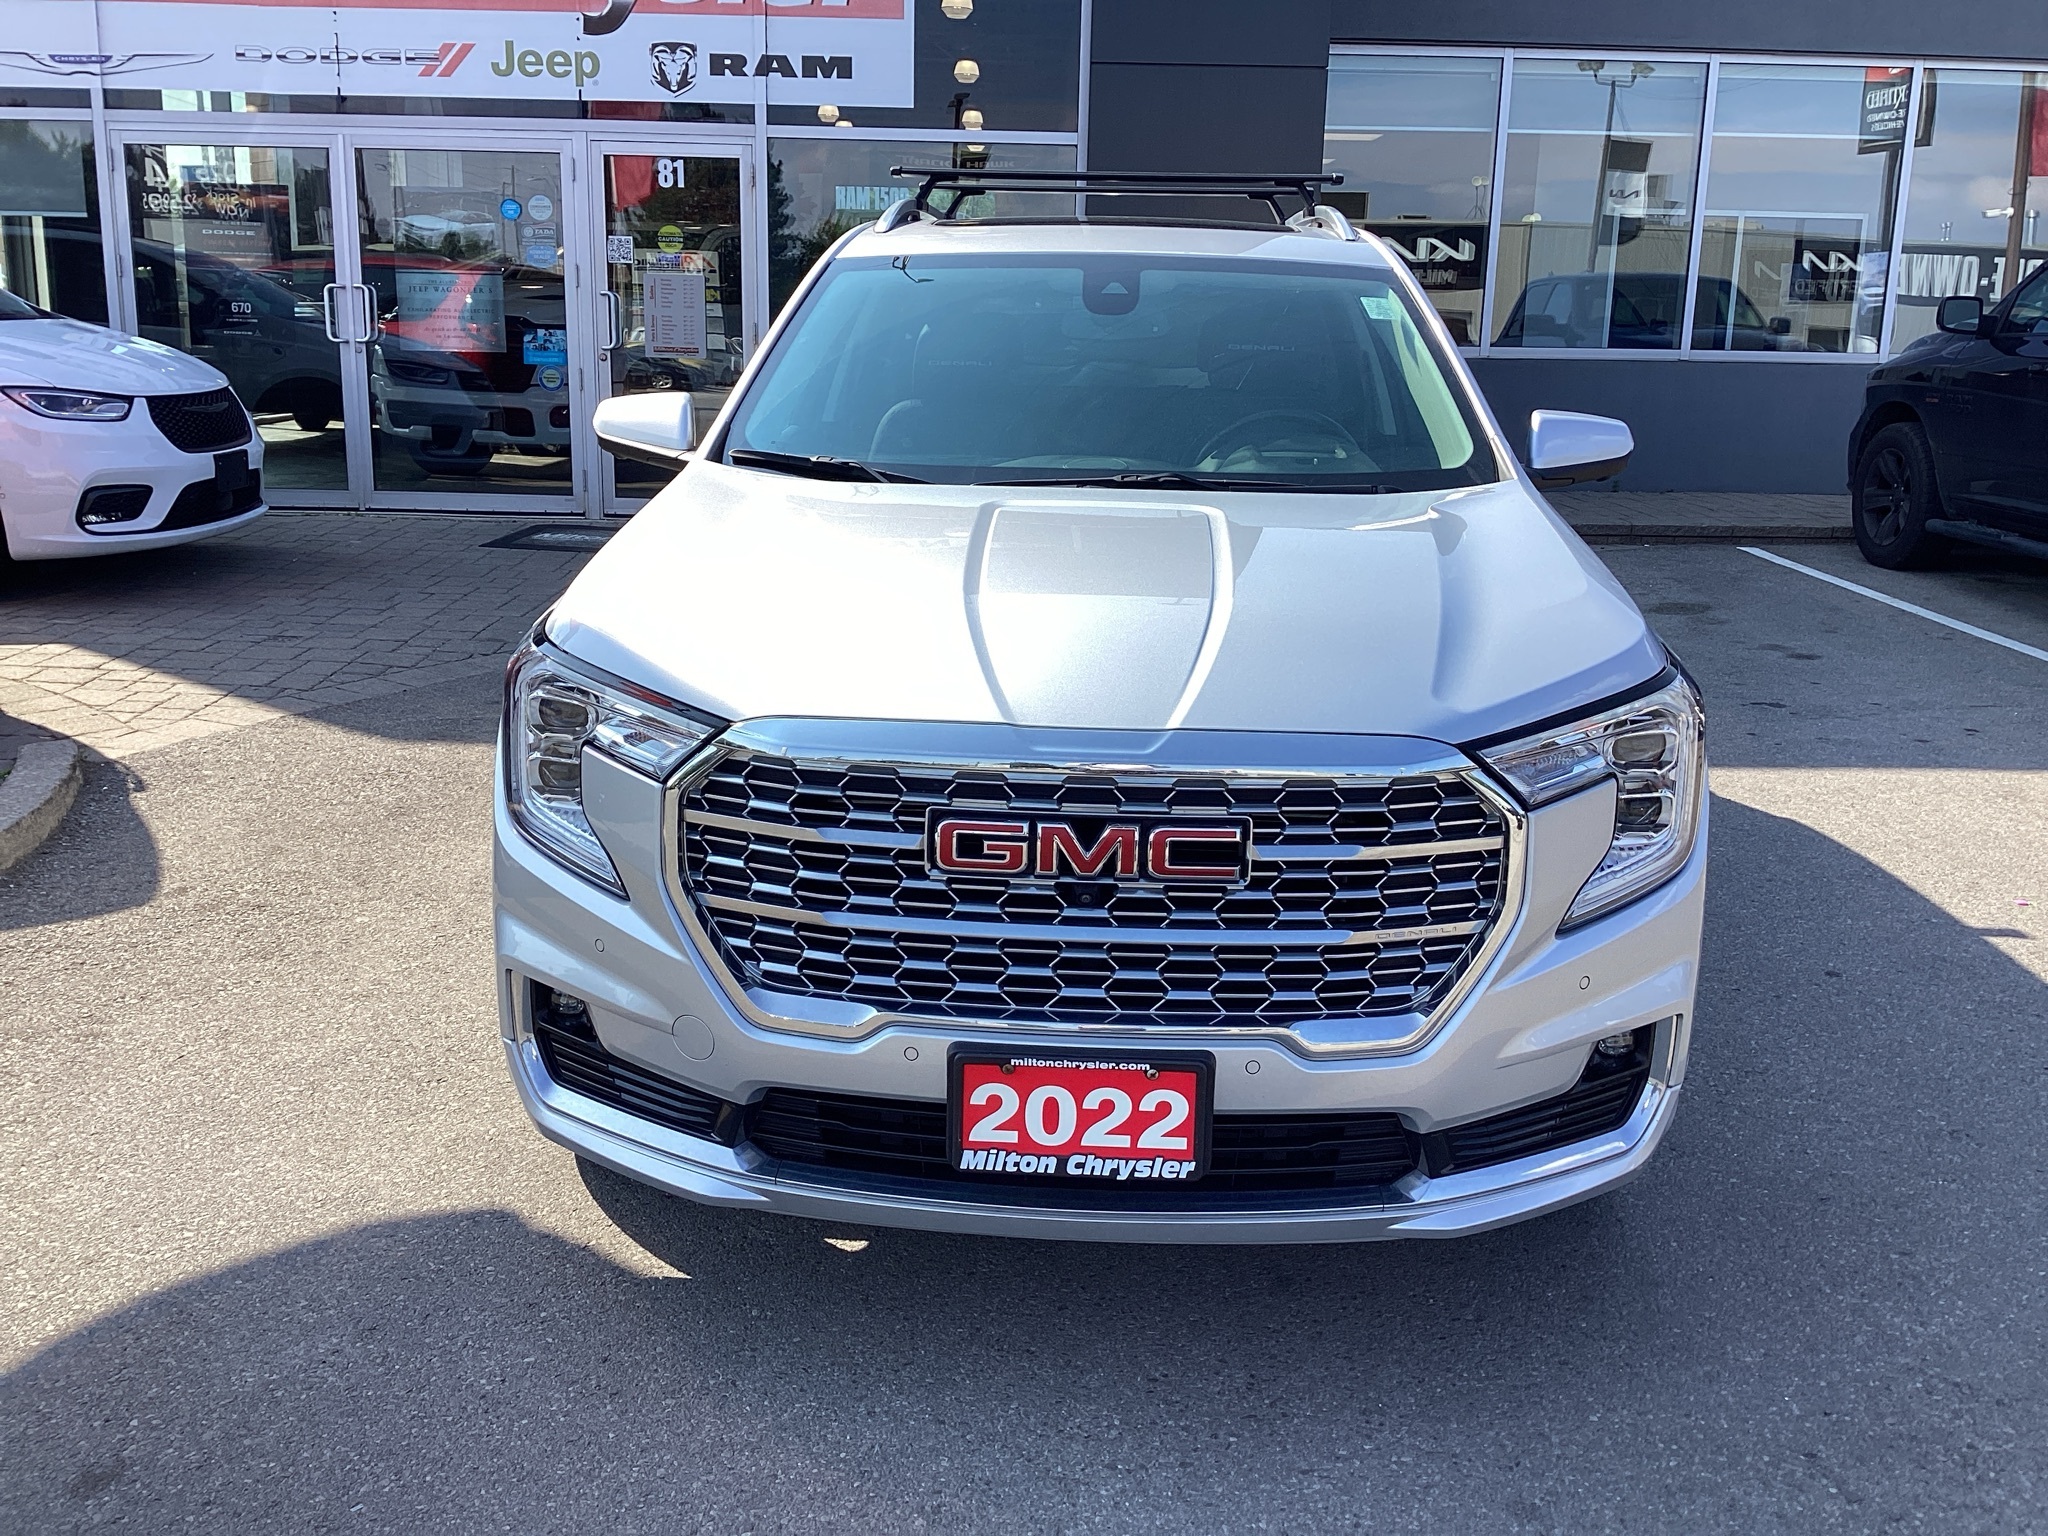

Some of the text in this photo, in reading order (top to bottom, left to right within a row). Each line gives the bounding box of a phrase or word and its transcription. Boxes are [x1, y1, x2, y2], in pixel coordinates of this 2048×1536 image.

[235, 45, 443, 66] DODGE
[491, 40, 600, 87] Jeep
[709, 53, 853, 79] RAM
[657, 158, 685, 188] 81
[836, 186, 870, 210] RAM
[408, 285, 429, 293] JEEP
[231, 302, 252, 313] 670
[935, 818, 1243, 881] GMC
[1375, 926, 1457, 940] DENALI
[1010, 1057, 1151, 1072] miltonchrysler.com
[968, 1082, 1190, 1151] 2022
[960, 1149, 1196, 1181] Milton Chrysler
